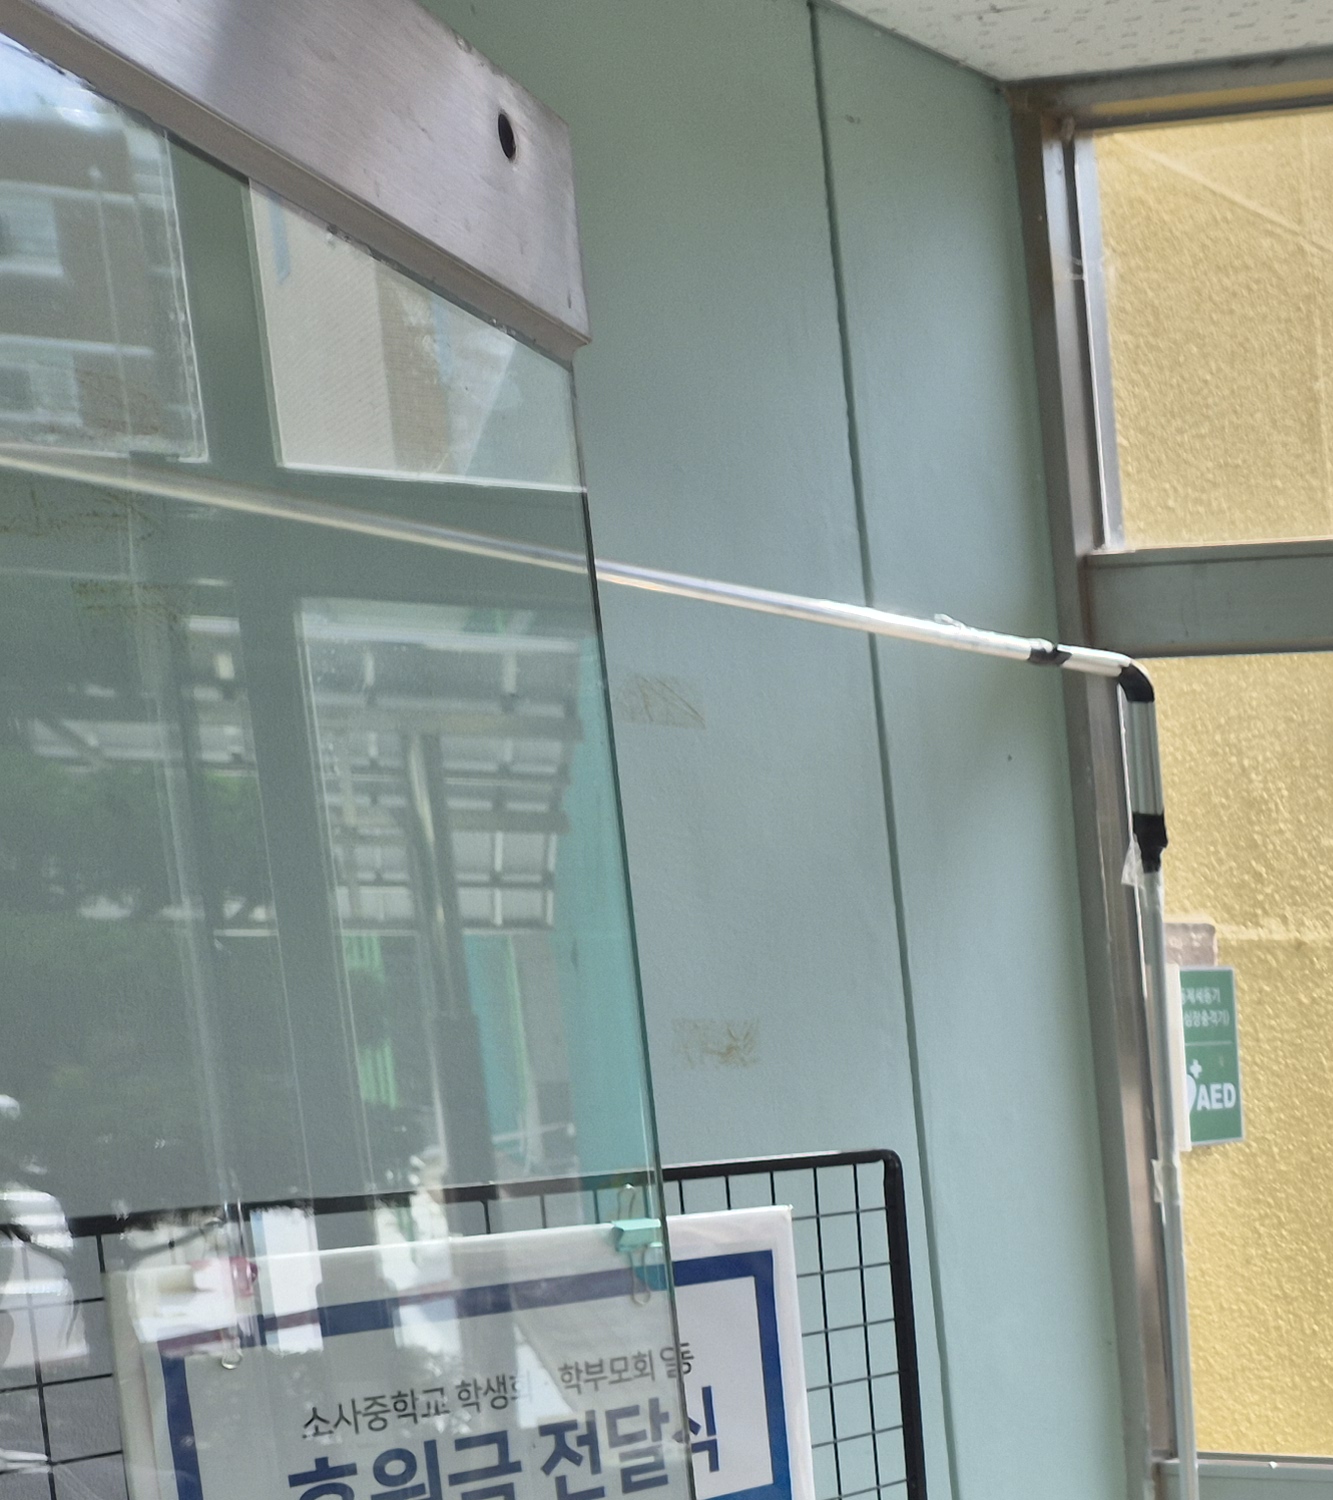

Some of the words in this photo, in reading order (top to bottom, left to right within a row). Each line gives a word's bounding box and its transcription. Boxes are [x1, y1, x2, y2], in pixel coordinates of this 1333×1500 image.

[1196, 1083, 1237, 1111] AED
[301, 1386, 451, 1439] 소사중학교
[557, 1350, 656, 1395] 학부모회
